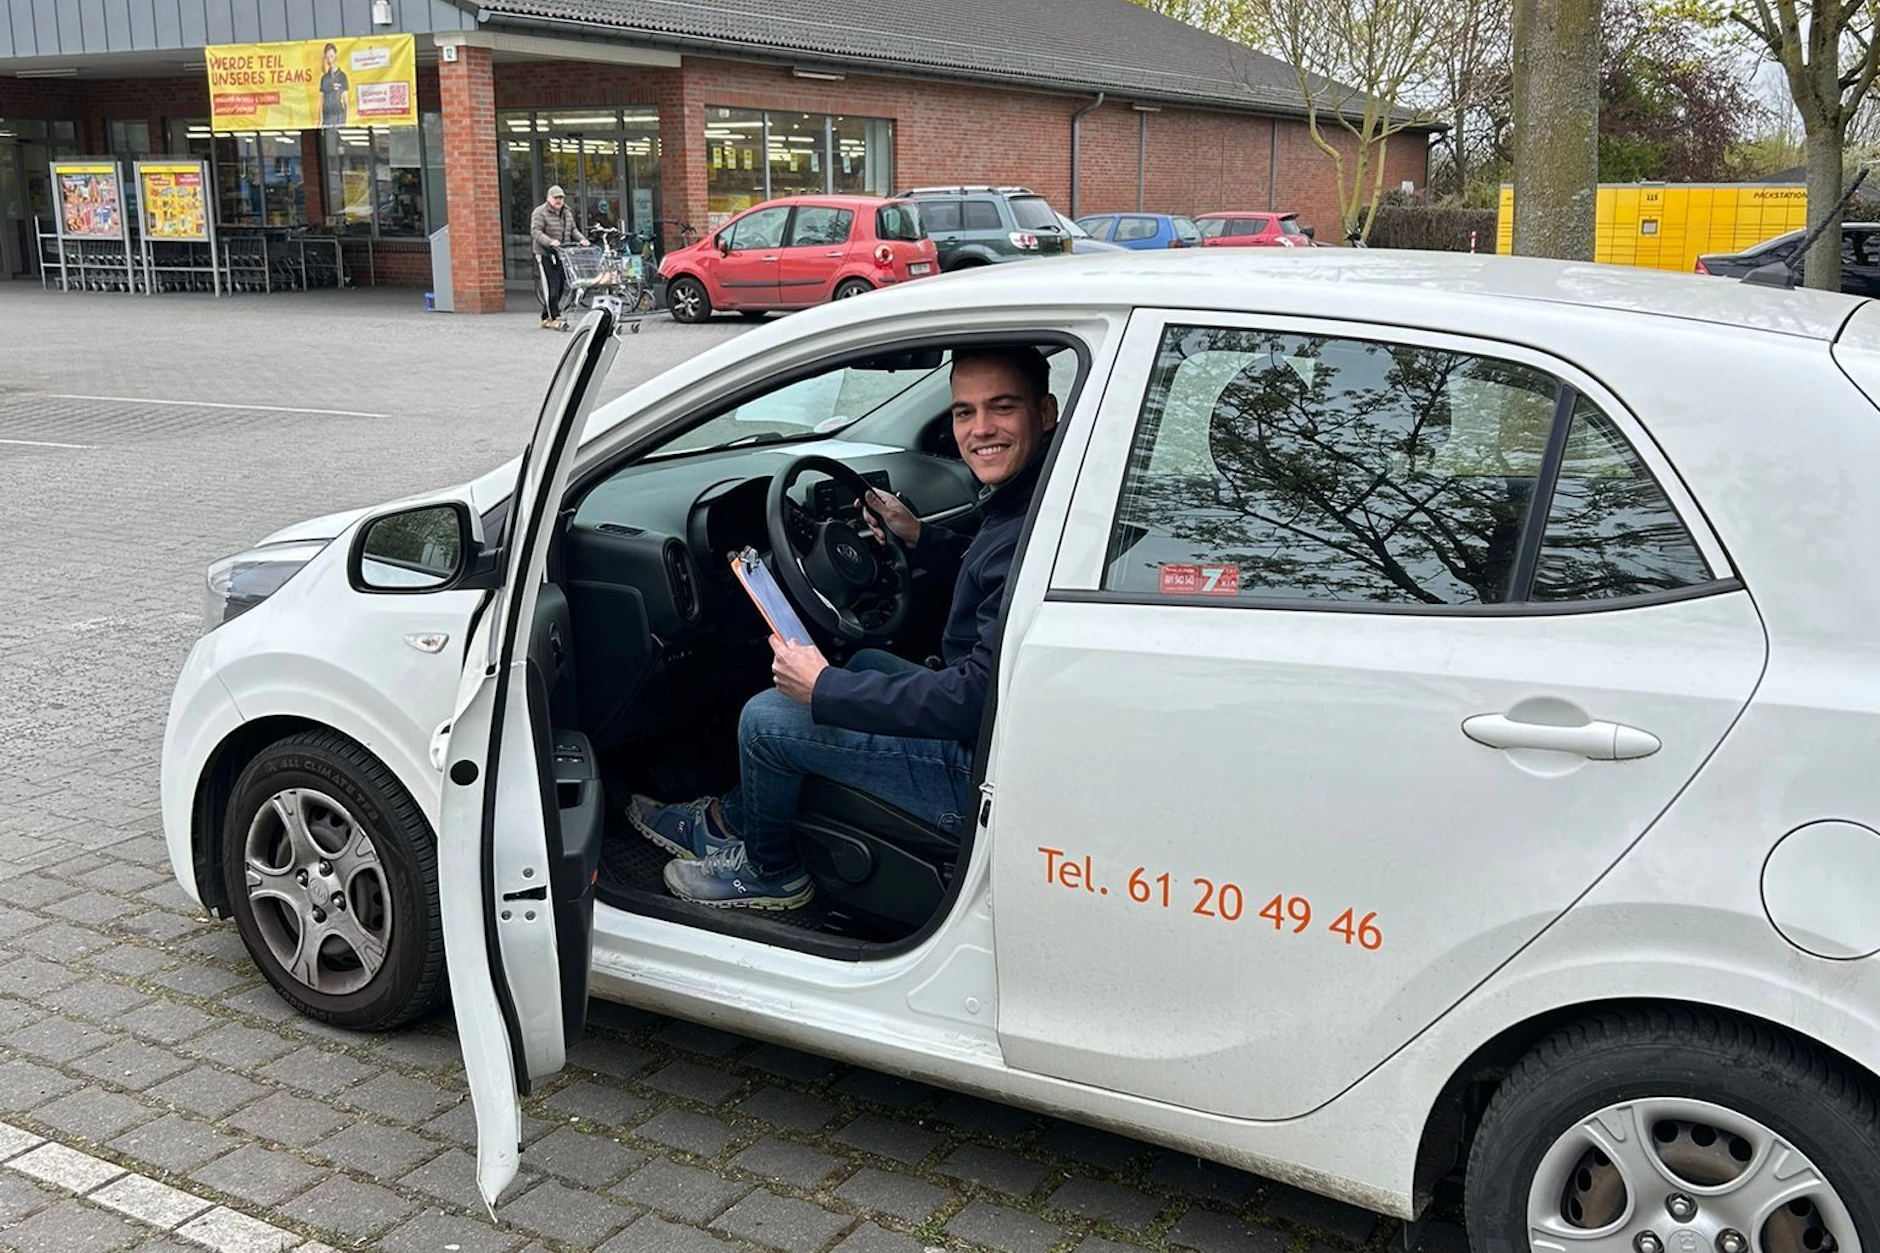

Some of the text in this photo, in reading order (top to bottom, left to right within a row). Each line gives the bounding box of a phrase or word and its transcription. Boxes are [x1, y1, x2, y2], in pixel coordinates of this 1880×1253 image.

[209, 54, 284, 71] WERDE TEIL
[211, 68, 312, 86] UNSERES TEAMS
[1753, 191, 1808, 199] PACKSTATION
[281, 759, 300, 768] ALL
[1038, 847, 1383, 950] Tel. 61 20 49 46
